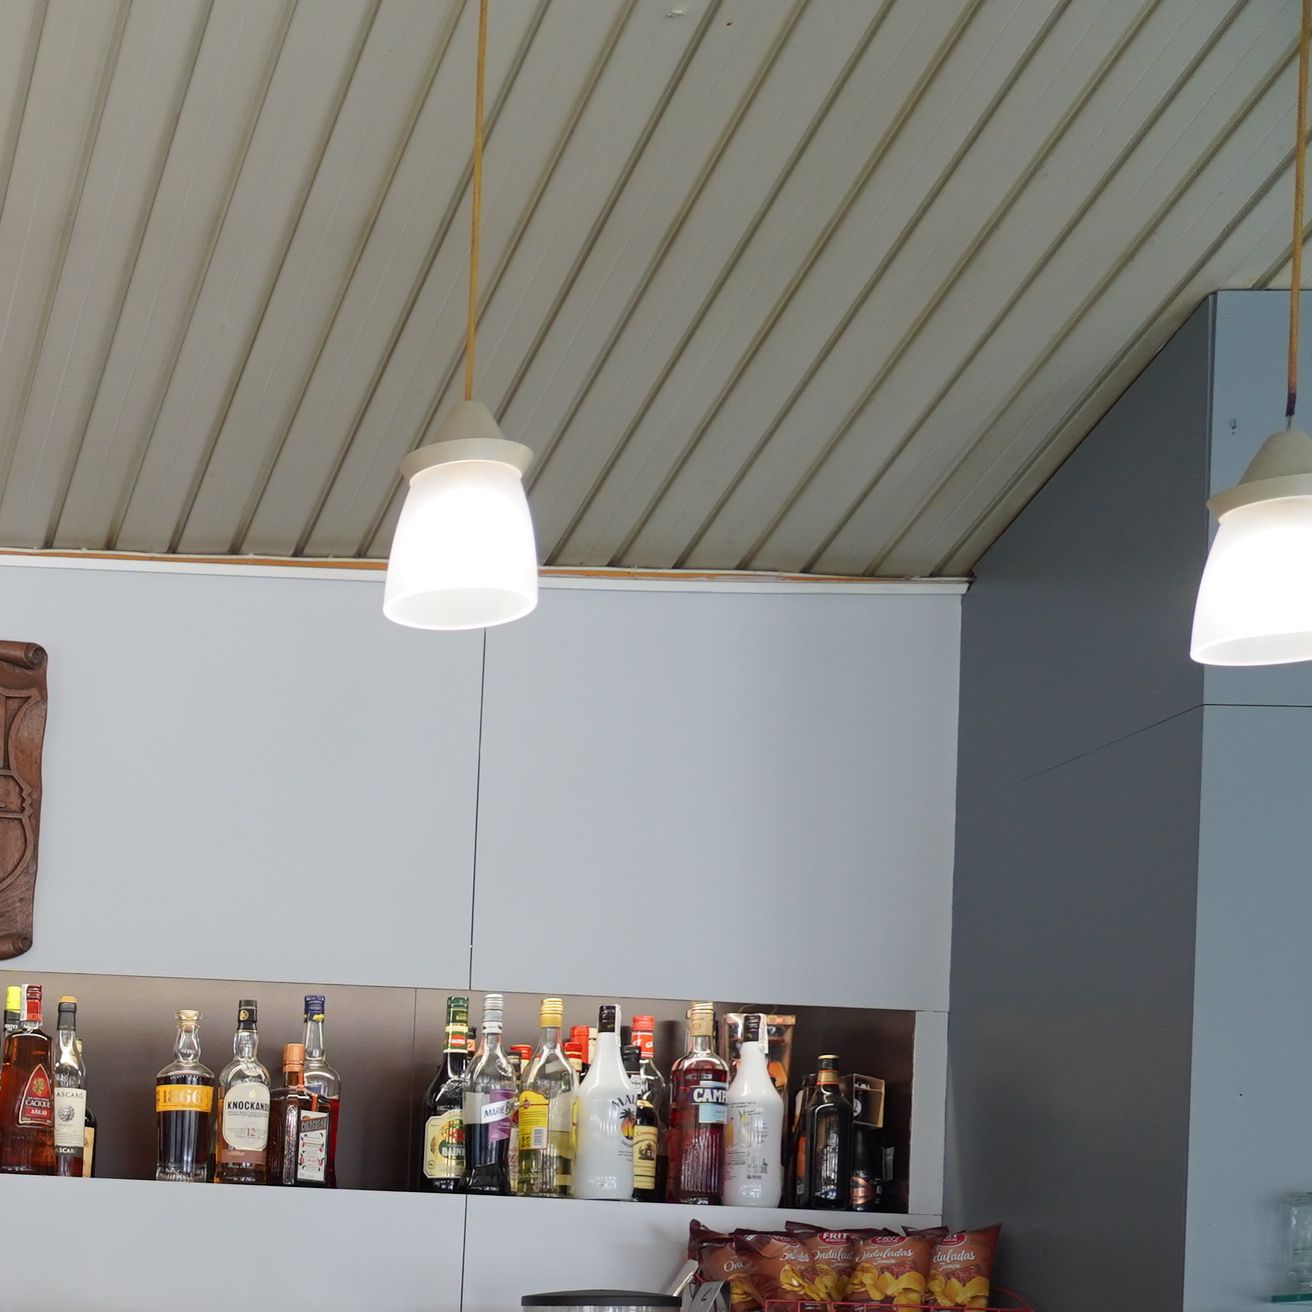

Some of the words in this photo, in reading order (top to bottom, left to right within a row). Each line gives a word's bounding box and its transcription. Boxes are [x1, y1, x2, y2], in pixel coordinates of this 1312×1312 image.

[245, 1128, 256, 1137] 12
[823, 1232, 848, 1240] FRIT
[933, 1249, 976, 1263] duladas
